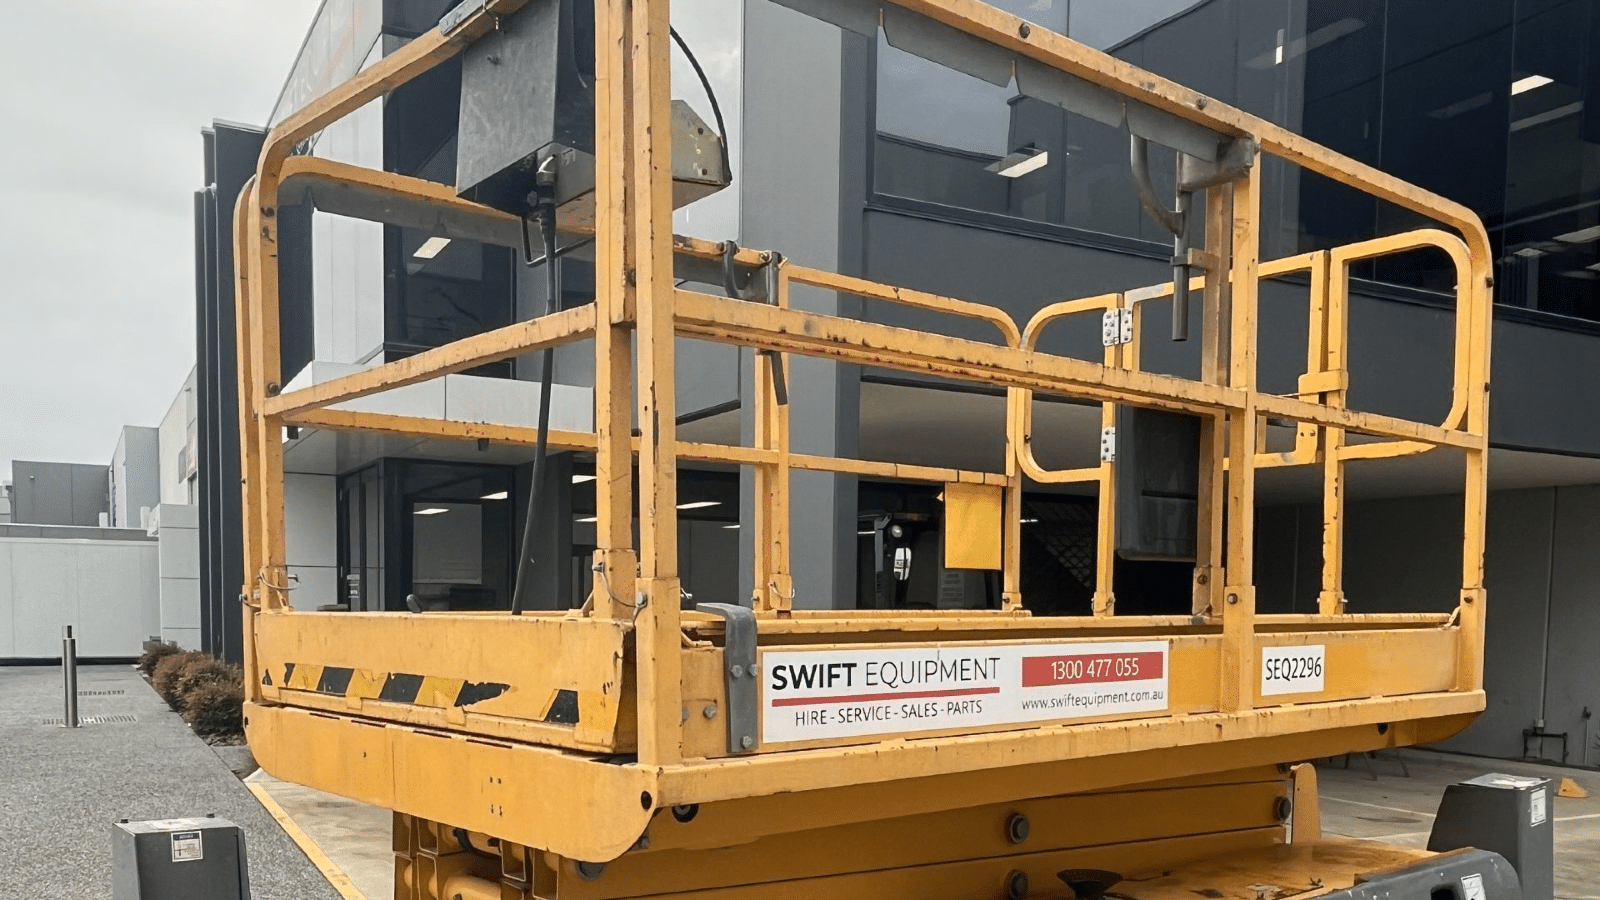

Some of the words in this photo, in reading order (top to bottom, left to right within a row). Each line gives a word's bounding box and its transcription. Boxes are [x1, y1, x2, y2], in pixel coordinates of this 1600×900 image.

[771, 663, 857, 690] SWIFT
[865, 658, 1001, 688] EQUIPMENT
[1051, 660, 1083, 679] 1300
[1087, 659, 1112, 677] 477
[1115, 658, 1140, 676] 055
[1265, 657, 1322, 681] SEQ2296
[1021, 691, 1164, 710] www.swiftequipment.com.au
